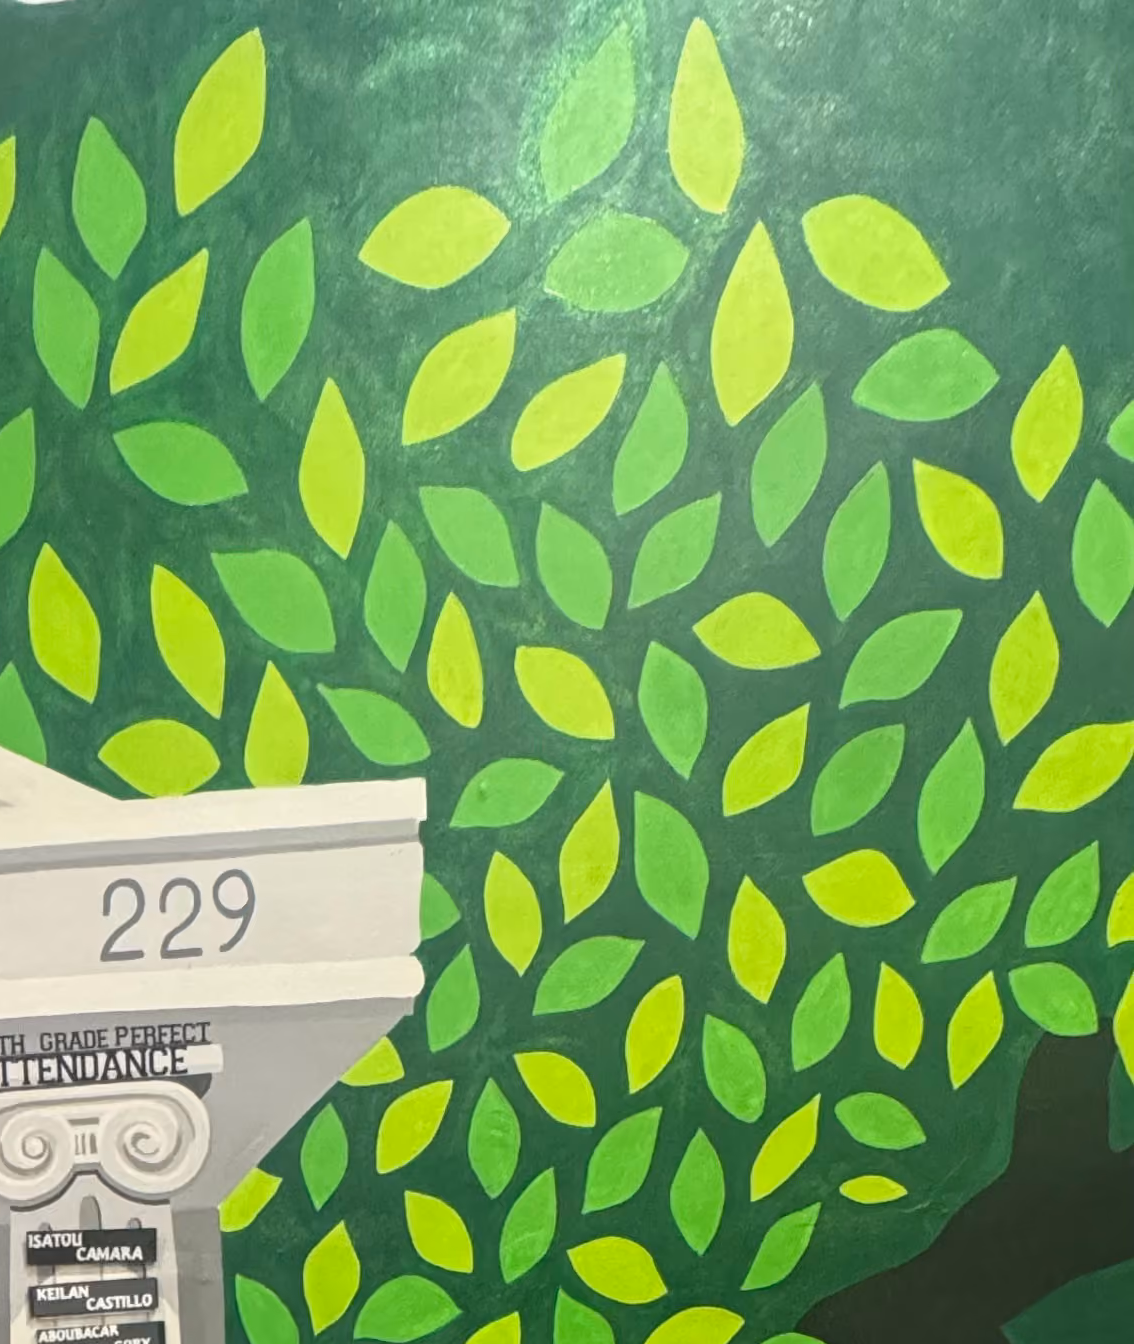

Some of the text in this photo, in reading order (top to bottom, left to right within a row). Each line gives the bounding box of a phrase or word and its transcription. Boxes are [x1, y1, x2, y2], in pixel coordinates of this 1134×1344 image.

[100, 869, 256, 962] 229
[40, 1029, 109, 1052] GRADE
[115, 1022, 211, 1047] PERFECT
[28, 1232, 83, 1248] ISATOU
[76, 1246, 143, 1261] CAMARA
[36, 1286, 89, 1301] KEILAN
[86, 1293, 153, 1311] CASTILLO
[38, 1325, 120, 1344] ABOUBACAR
